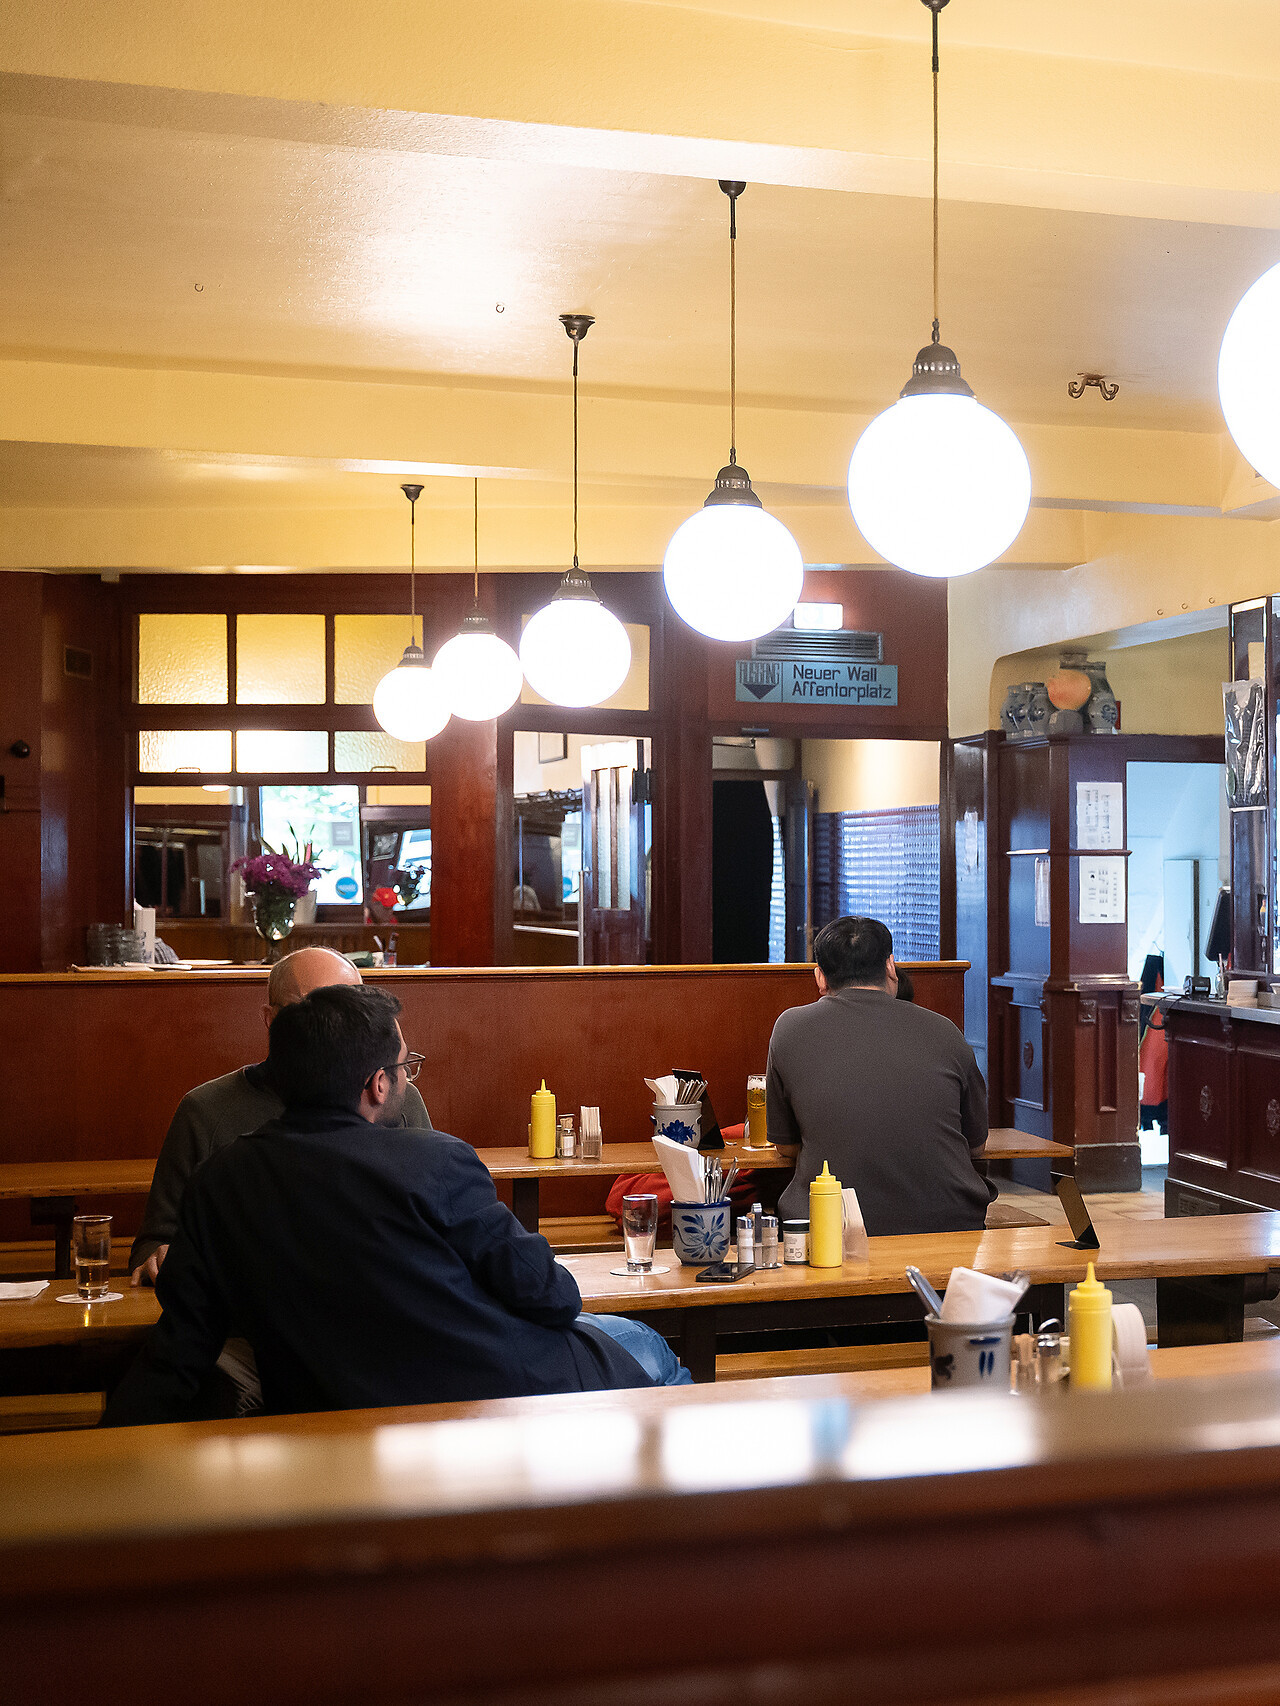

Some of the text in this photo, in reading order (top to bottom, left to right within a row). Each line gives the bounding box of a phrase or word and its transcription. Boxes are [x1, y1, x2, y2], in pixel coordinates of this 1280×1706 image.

[793, 664, 877, 682] Neuer Wall
[792, 681, 892, 703] Affentorplatz
